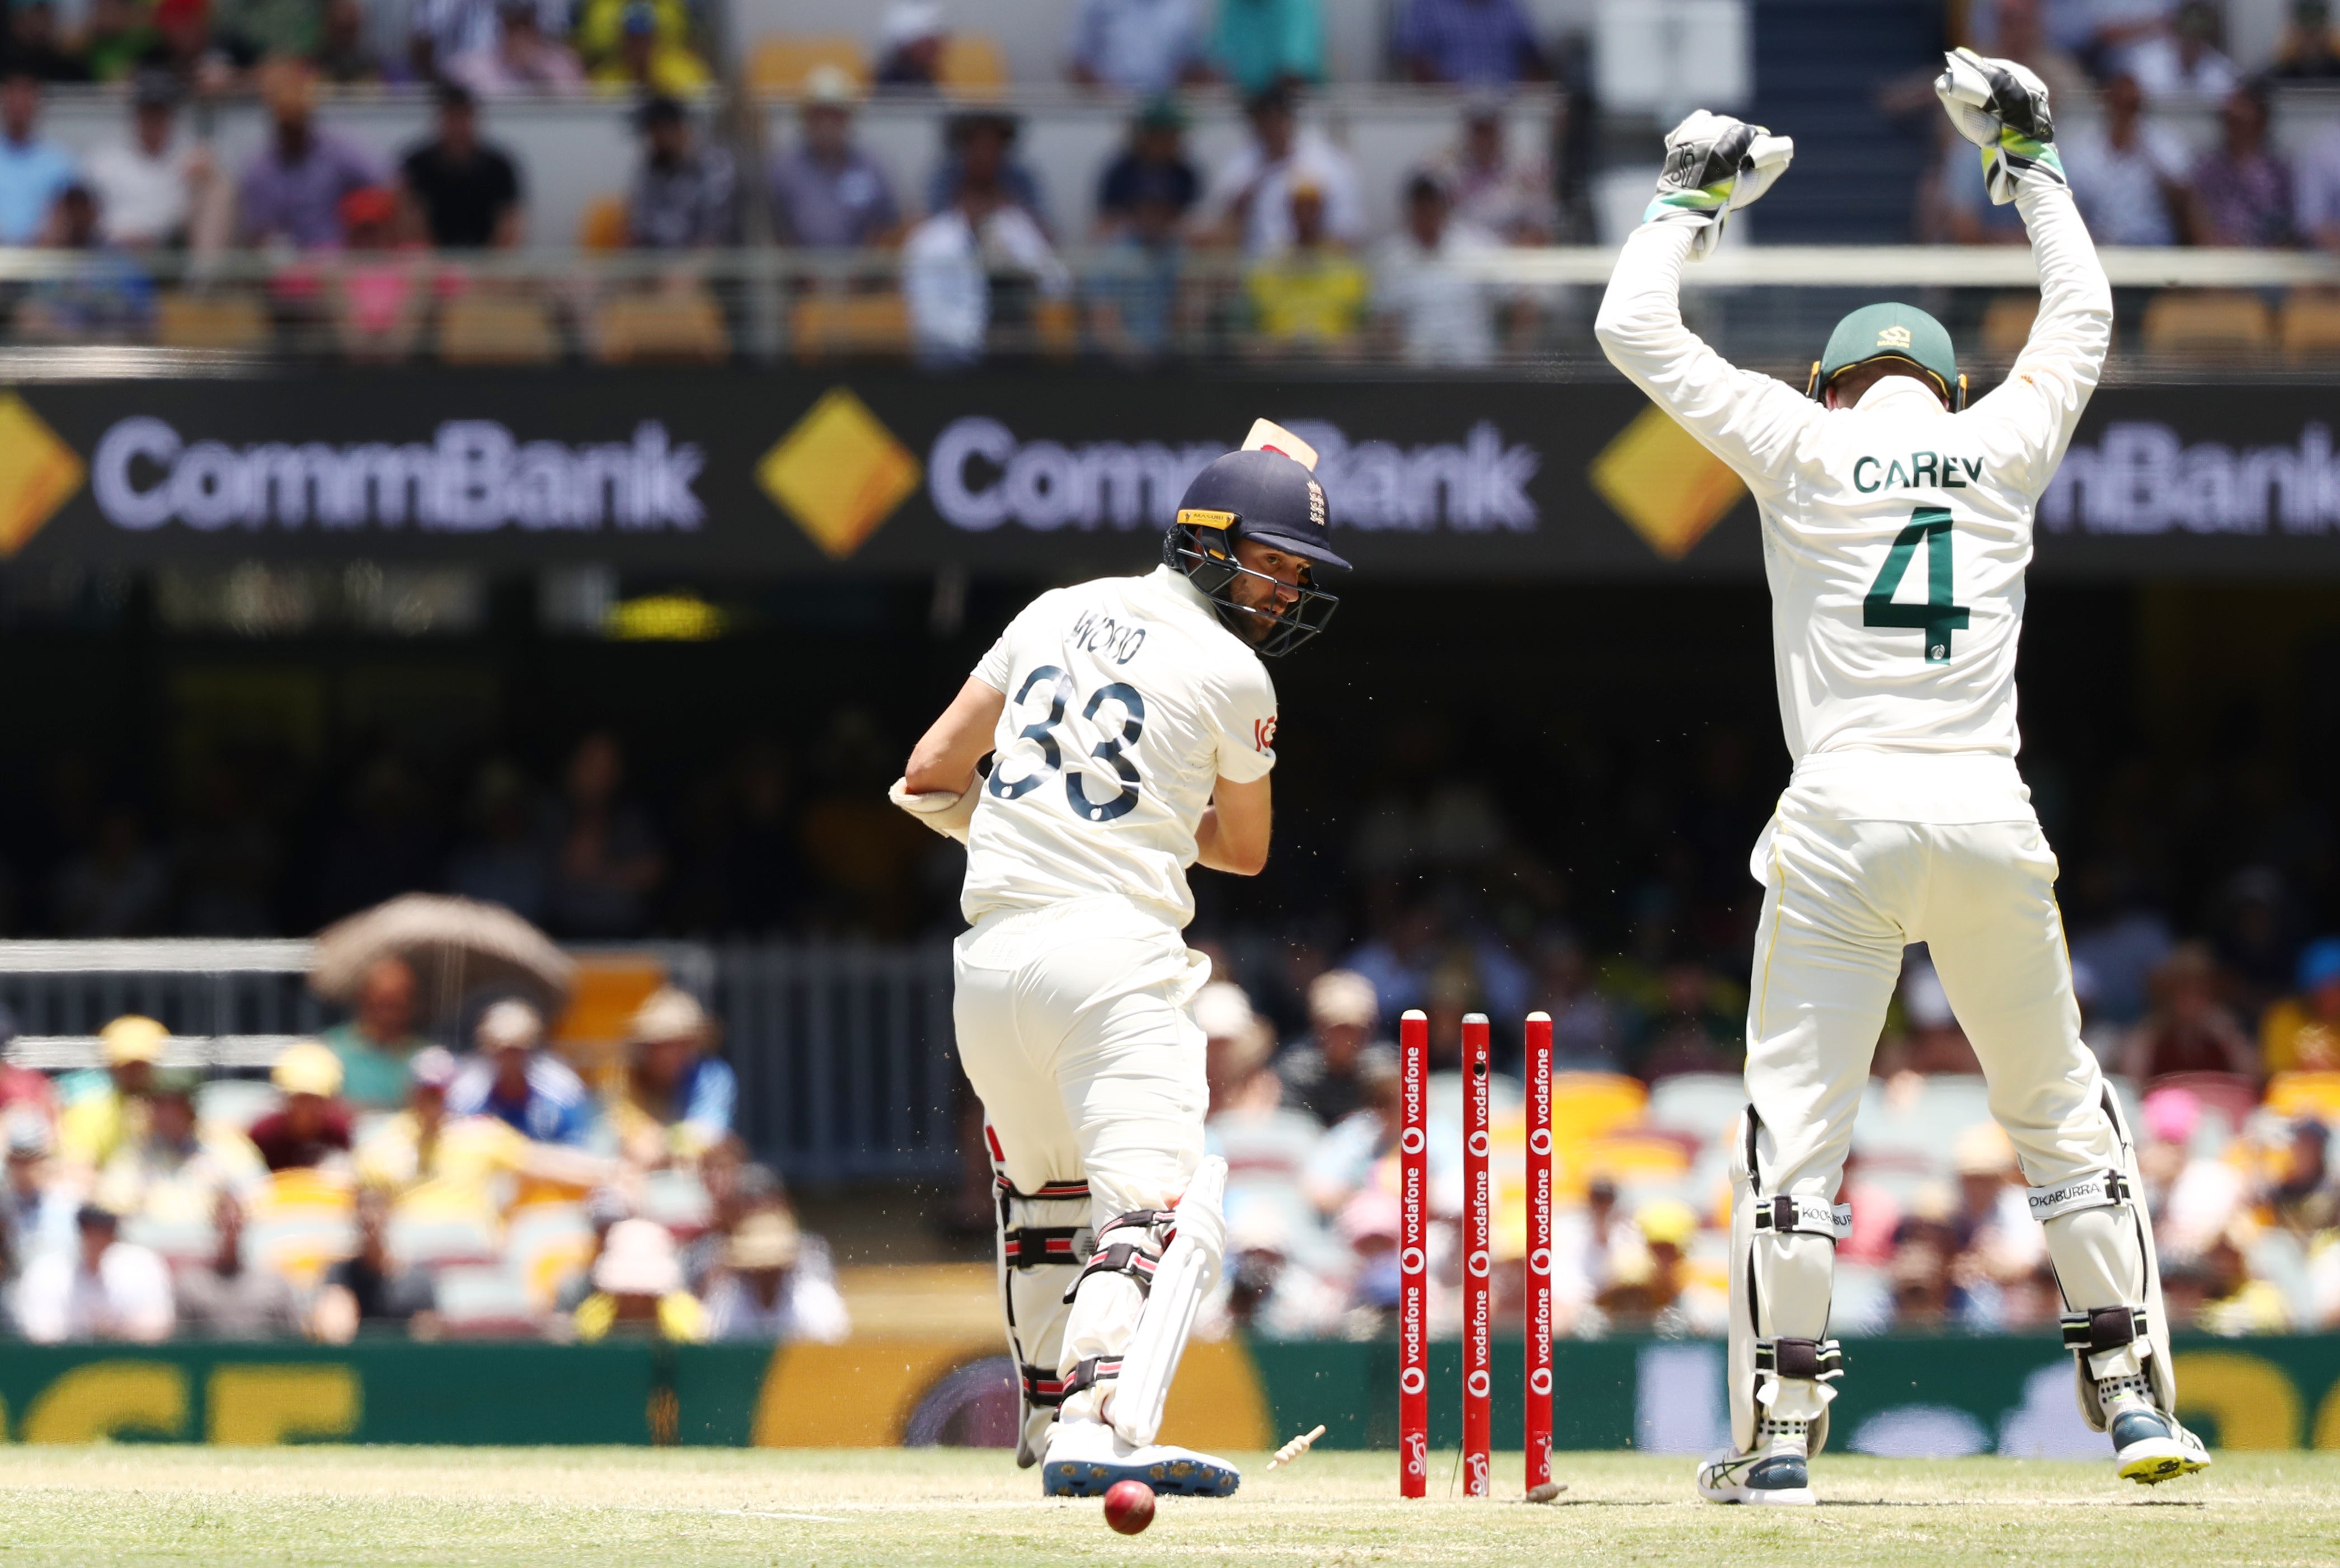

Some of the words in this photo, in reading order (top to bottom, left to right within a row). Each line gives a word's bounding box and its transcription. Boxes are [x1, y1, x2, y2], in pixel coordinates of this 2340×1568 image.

[92, 415, 706, 532] CommBank
[1853, 450, 1984, 494] CAREY
[1863, 506, 1970, 665] 4
[988, 665, 1145, 821] 33
[1405, 1047, 1419, 1123] vodafone
[1535, 1048, 1549, 1125] vodafone
[1405, 1167, 1419, 1243] vodafone
[1473, 1171, 1487, 1247] vodafone
[1535, 1168, 1549, 1245] vodafone
[1405, 1287, 1419, 1364] vodafone
[1473, 1290, 1487, 1366] vodafone
[1535, 1288, 1549, 1364] vodafone
